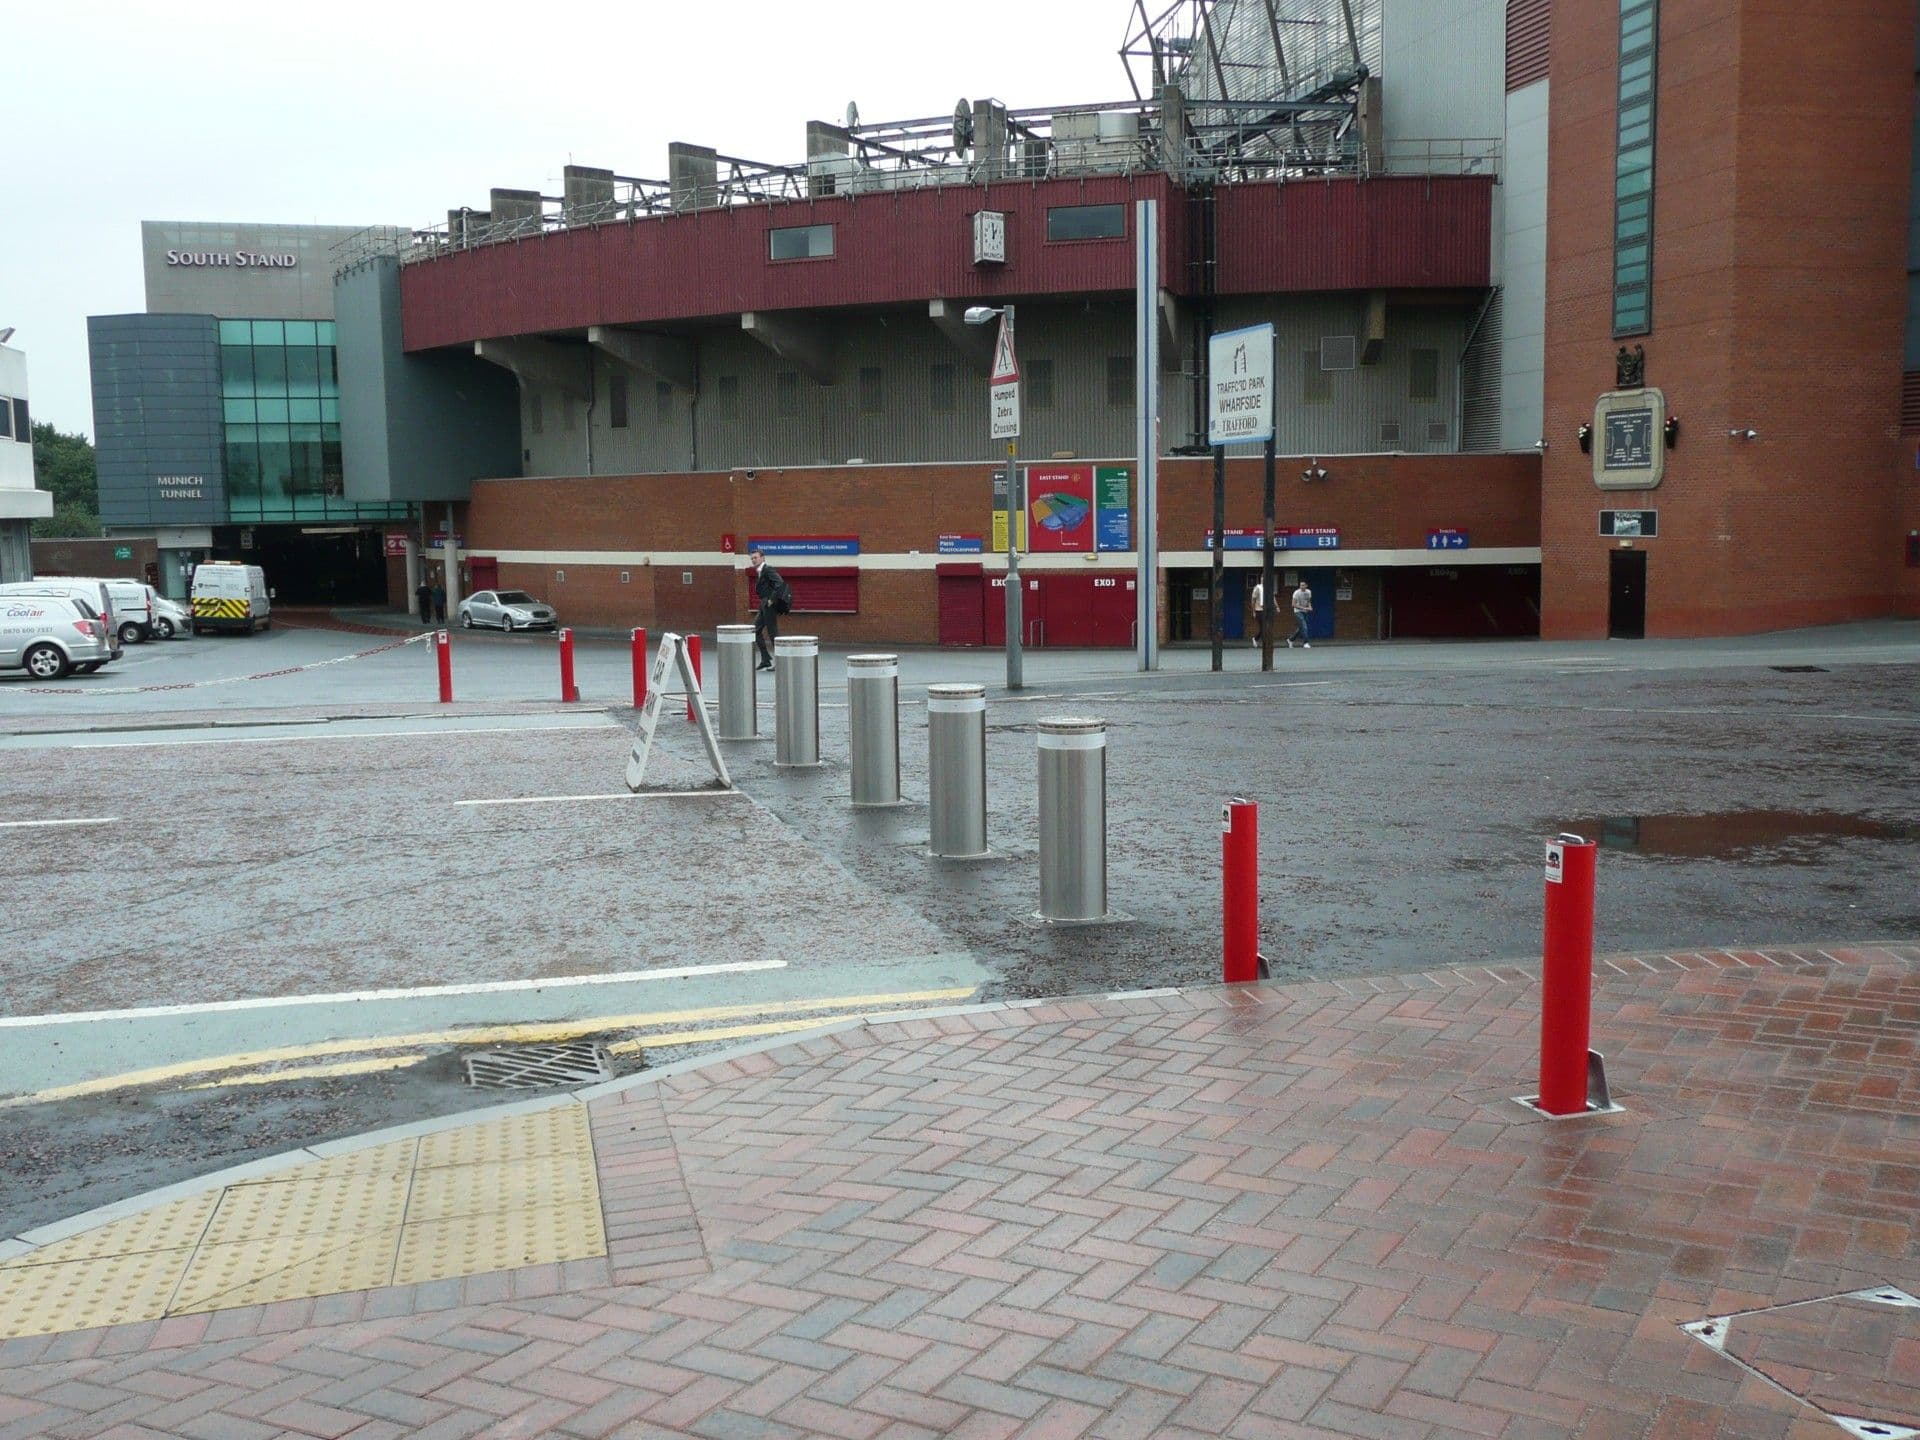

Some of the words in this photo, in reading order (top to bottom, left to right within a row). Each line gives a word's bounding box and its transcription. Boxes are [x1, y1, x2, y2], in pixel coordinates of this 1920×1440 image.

[166, 249, 230, 266] SOUTH
[235, 250, 297, 267] STAND
[1216, 380, 1247, 394] TRAFFORD
[1248, 376, 1265, 390] PARK
[994, 388, 1016, 401] Humped
[1219, 394, 1262, 414] WHARFSIDE
[997, 406, 1013, 418] Zebra
[993, 422, 1018, 434] Crossing
[1222, 416, 1258, 432] TRAFFORD
[157, 476, 203, 486] MUNICH
[160, 489, 203, 498] TUNNEL
[1318, 536, 1337, 546] E31
